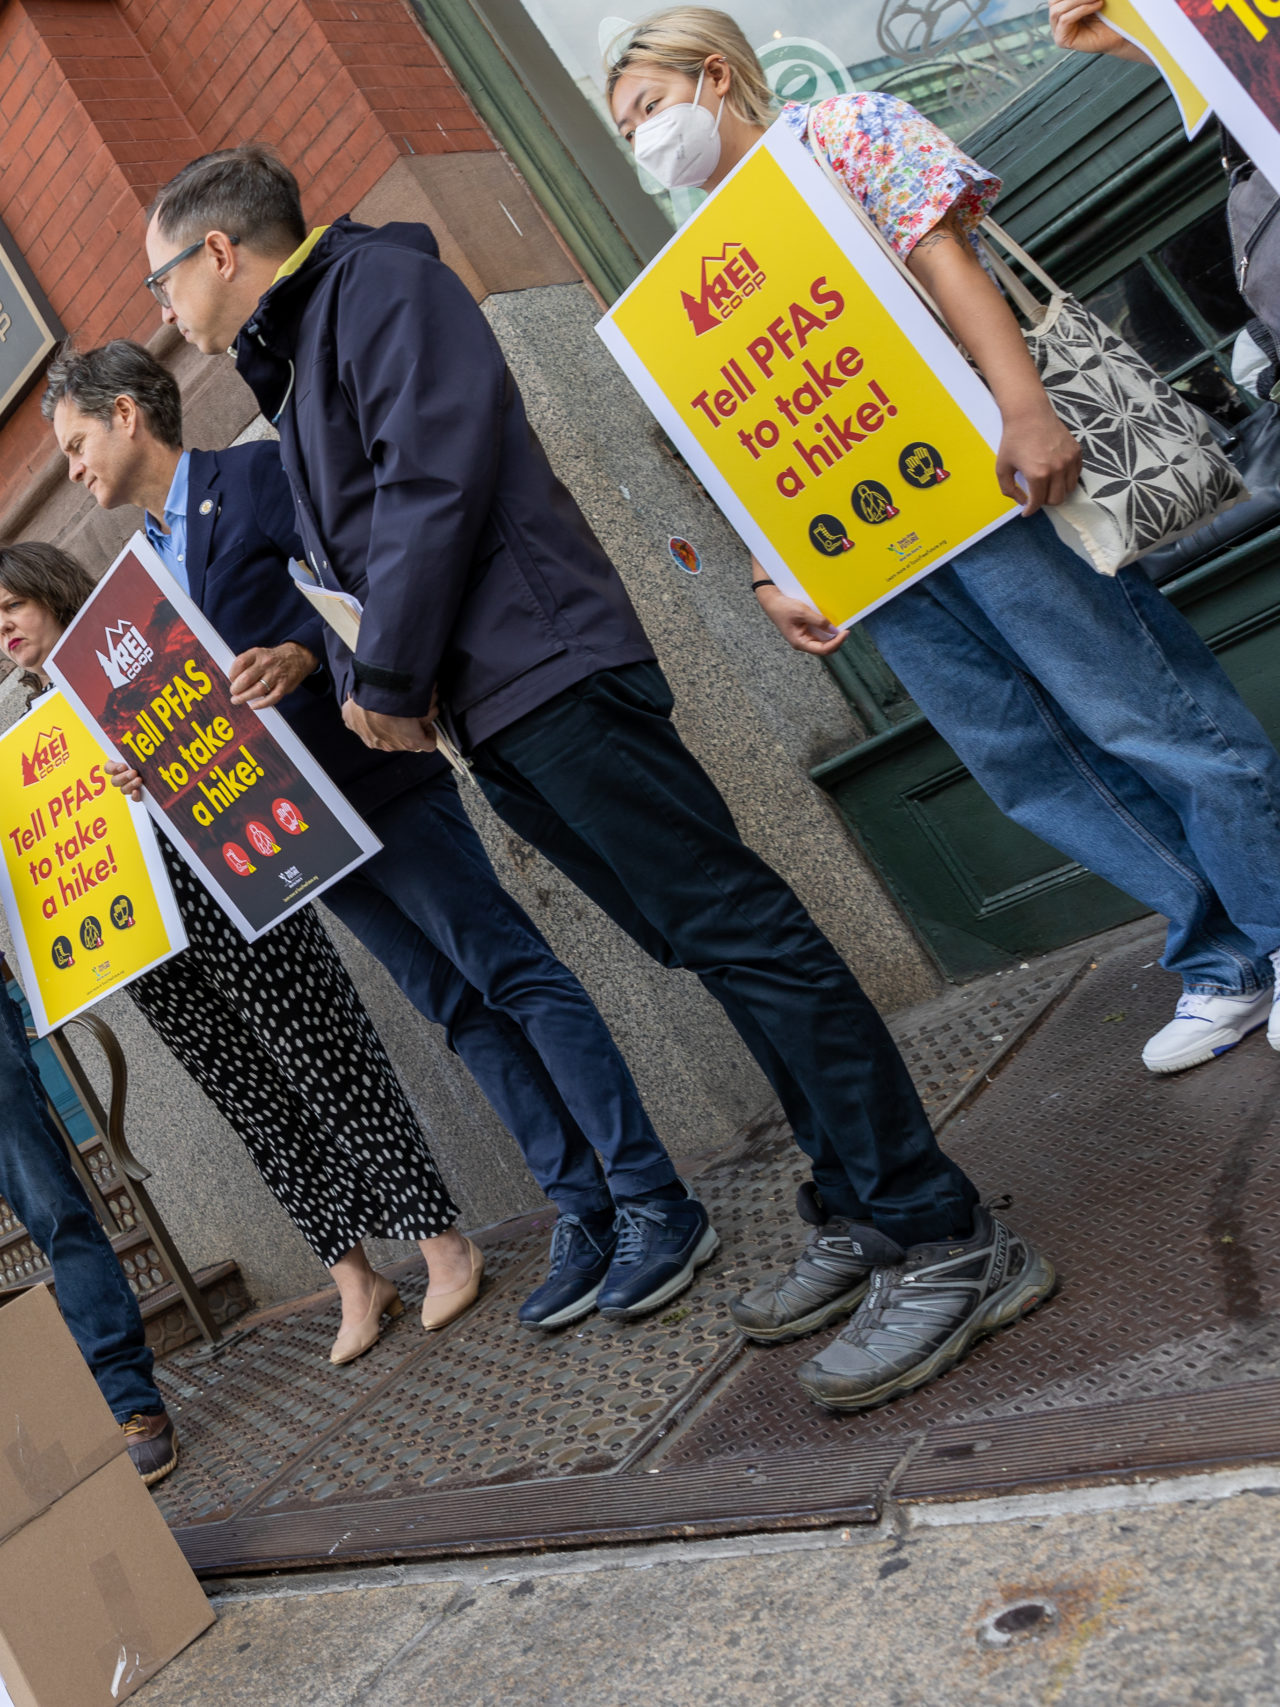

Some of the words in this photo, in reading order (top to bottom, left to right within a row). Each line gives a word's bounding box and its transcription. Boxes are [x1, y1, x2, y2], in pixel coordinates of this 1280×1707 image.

[707, 247, 760, 310] REI
[690, 357, 757, 429] Tell
[746, 276, 845, 379] PFAS
[737, 419, 780, 460] to
[774, 346, 864, 427] take
[776, 465, 806, 498] a
[792, 379, 898, 478] hike!
[117, 625, 148, 671] REI
[121, 709, 165, 763] Tell
[150, 659, 212, 732] PFAS
[35, 732, 68, 771] REI
[158, 761, 189, 793] to
[178, 715, 235, 772] take
[197, 744, 265, 814] hike!
[9, 807, 47, 857] Tell
[48, 764, 106, 828] PFAS
[192, 800, 215, 826] a
[29, 857, 52, 886] to
[54, 816, 108, 867] take
[42, 895, 58, 919] a
[58, 844, 118, 907] hike!
